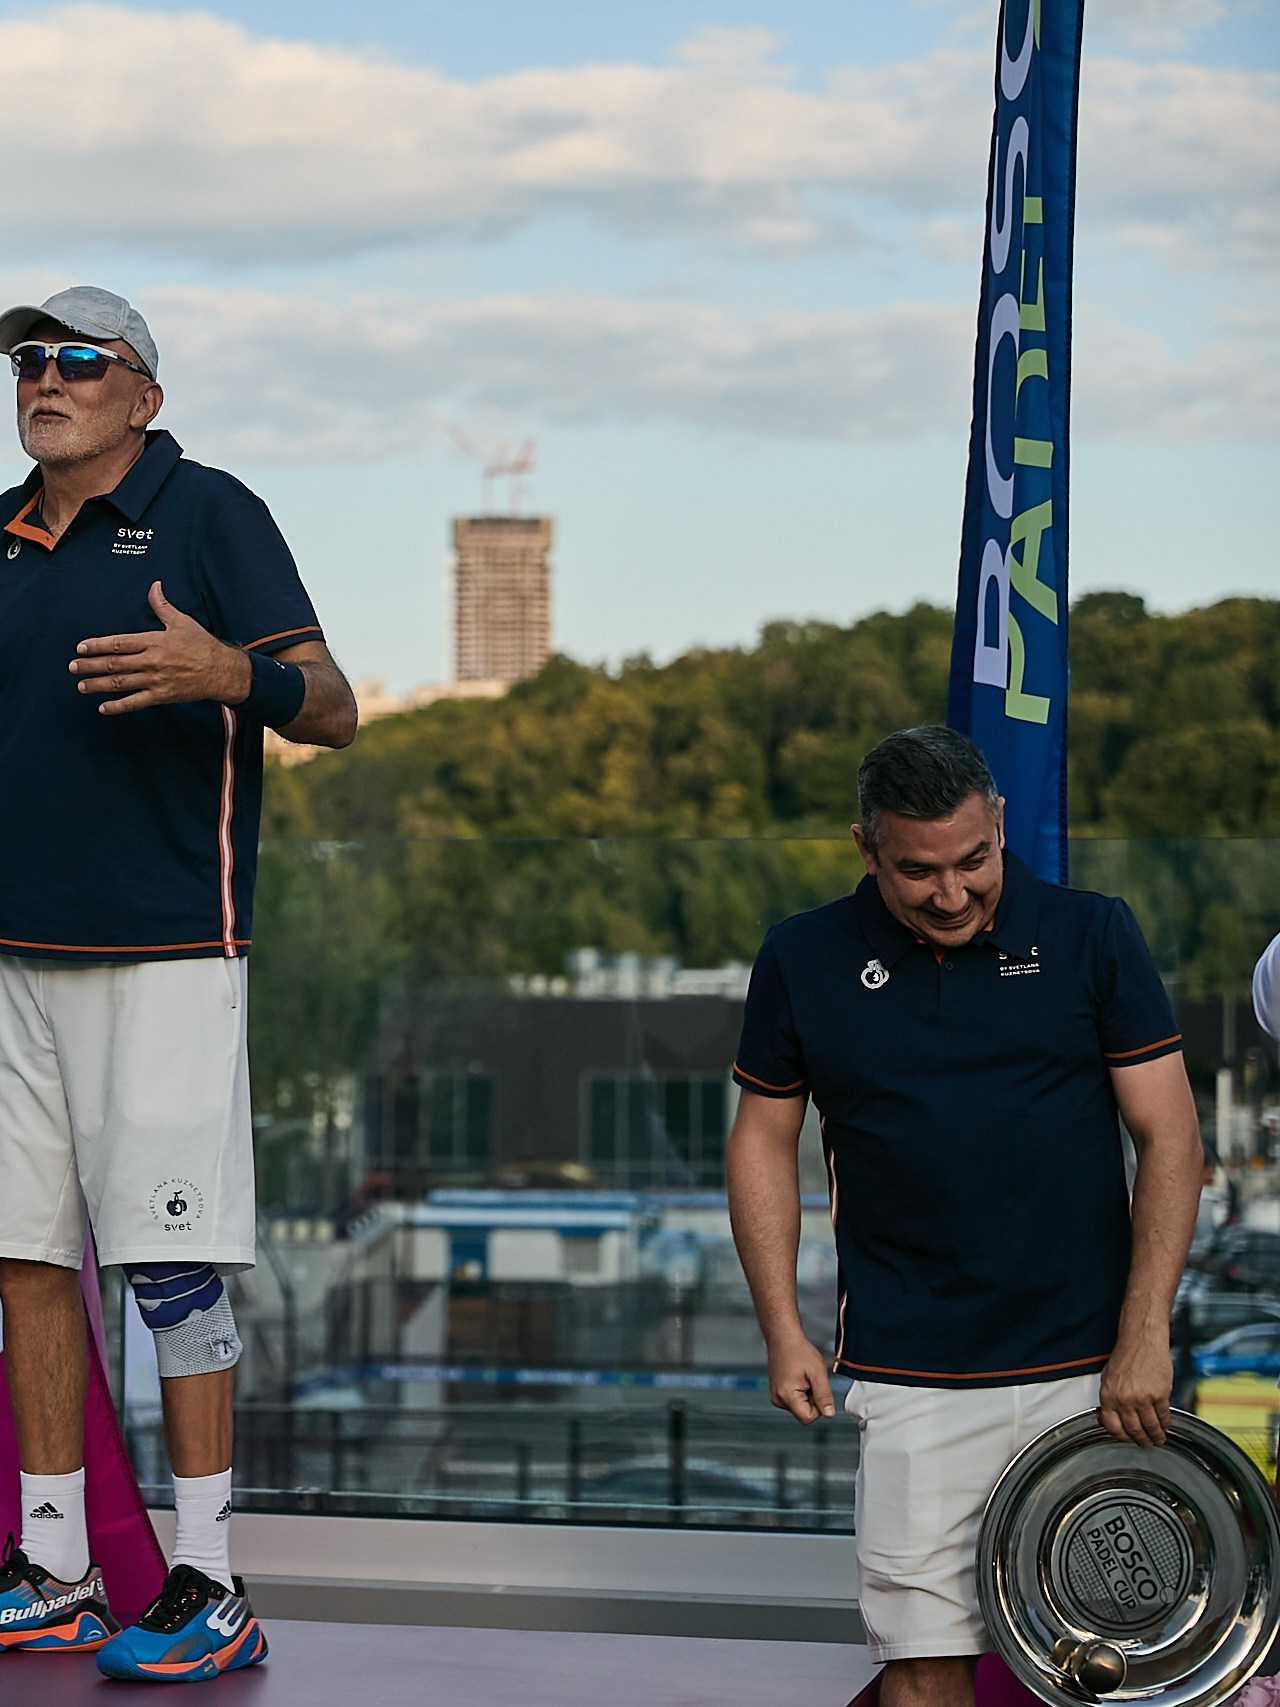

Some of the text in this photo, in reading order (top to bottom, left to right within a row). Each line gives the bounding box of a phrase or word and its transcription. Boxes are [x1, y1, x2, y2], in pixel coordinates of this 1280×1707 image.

[117, 528, 154, 540] svet
[149, 1178, 204, 1220] SVETLANA KUZNETSOVA
[164, 1221, 192, 1231] svet
[29, 1510, 64, 1519] adidas
[1087, 1527, 1137, 1610] PADEL CUP
[1104, 1515, 1158, 1601] BOSCO
[0, 1581, 96, 1625] Bullpadel
